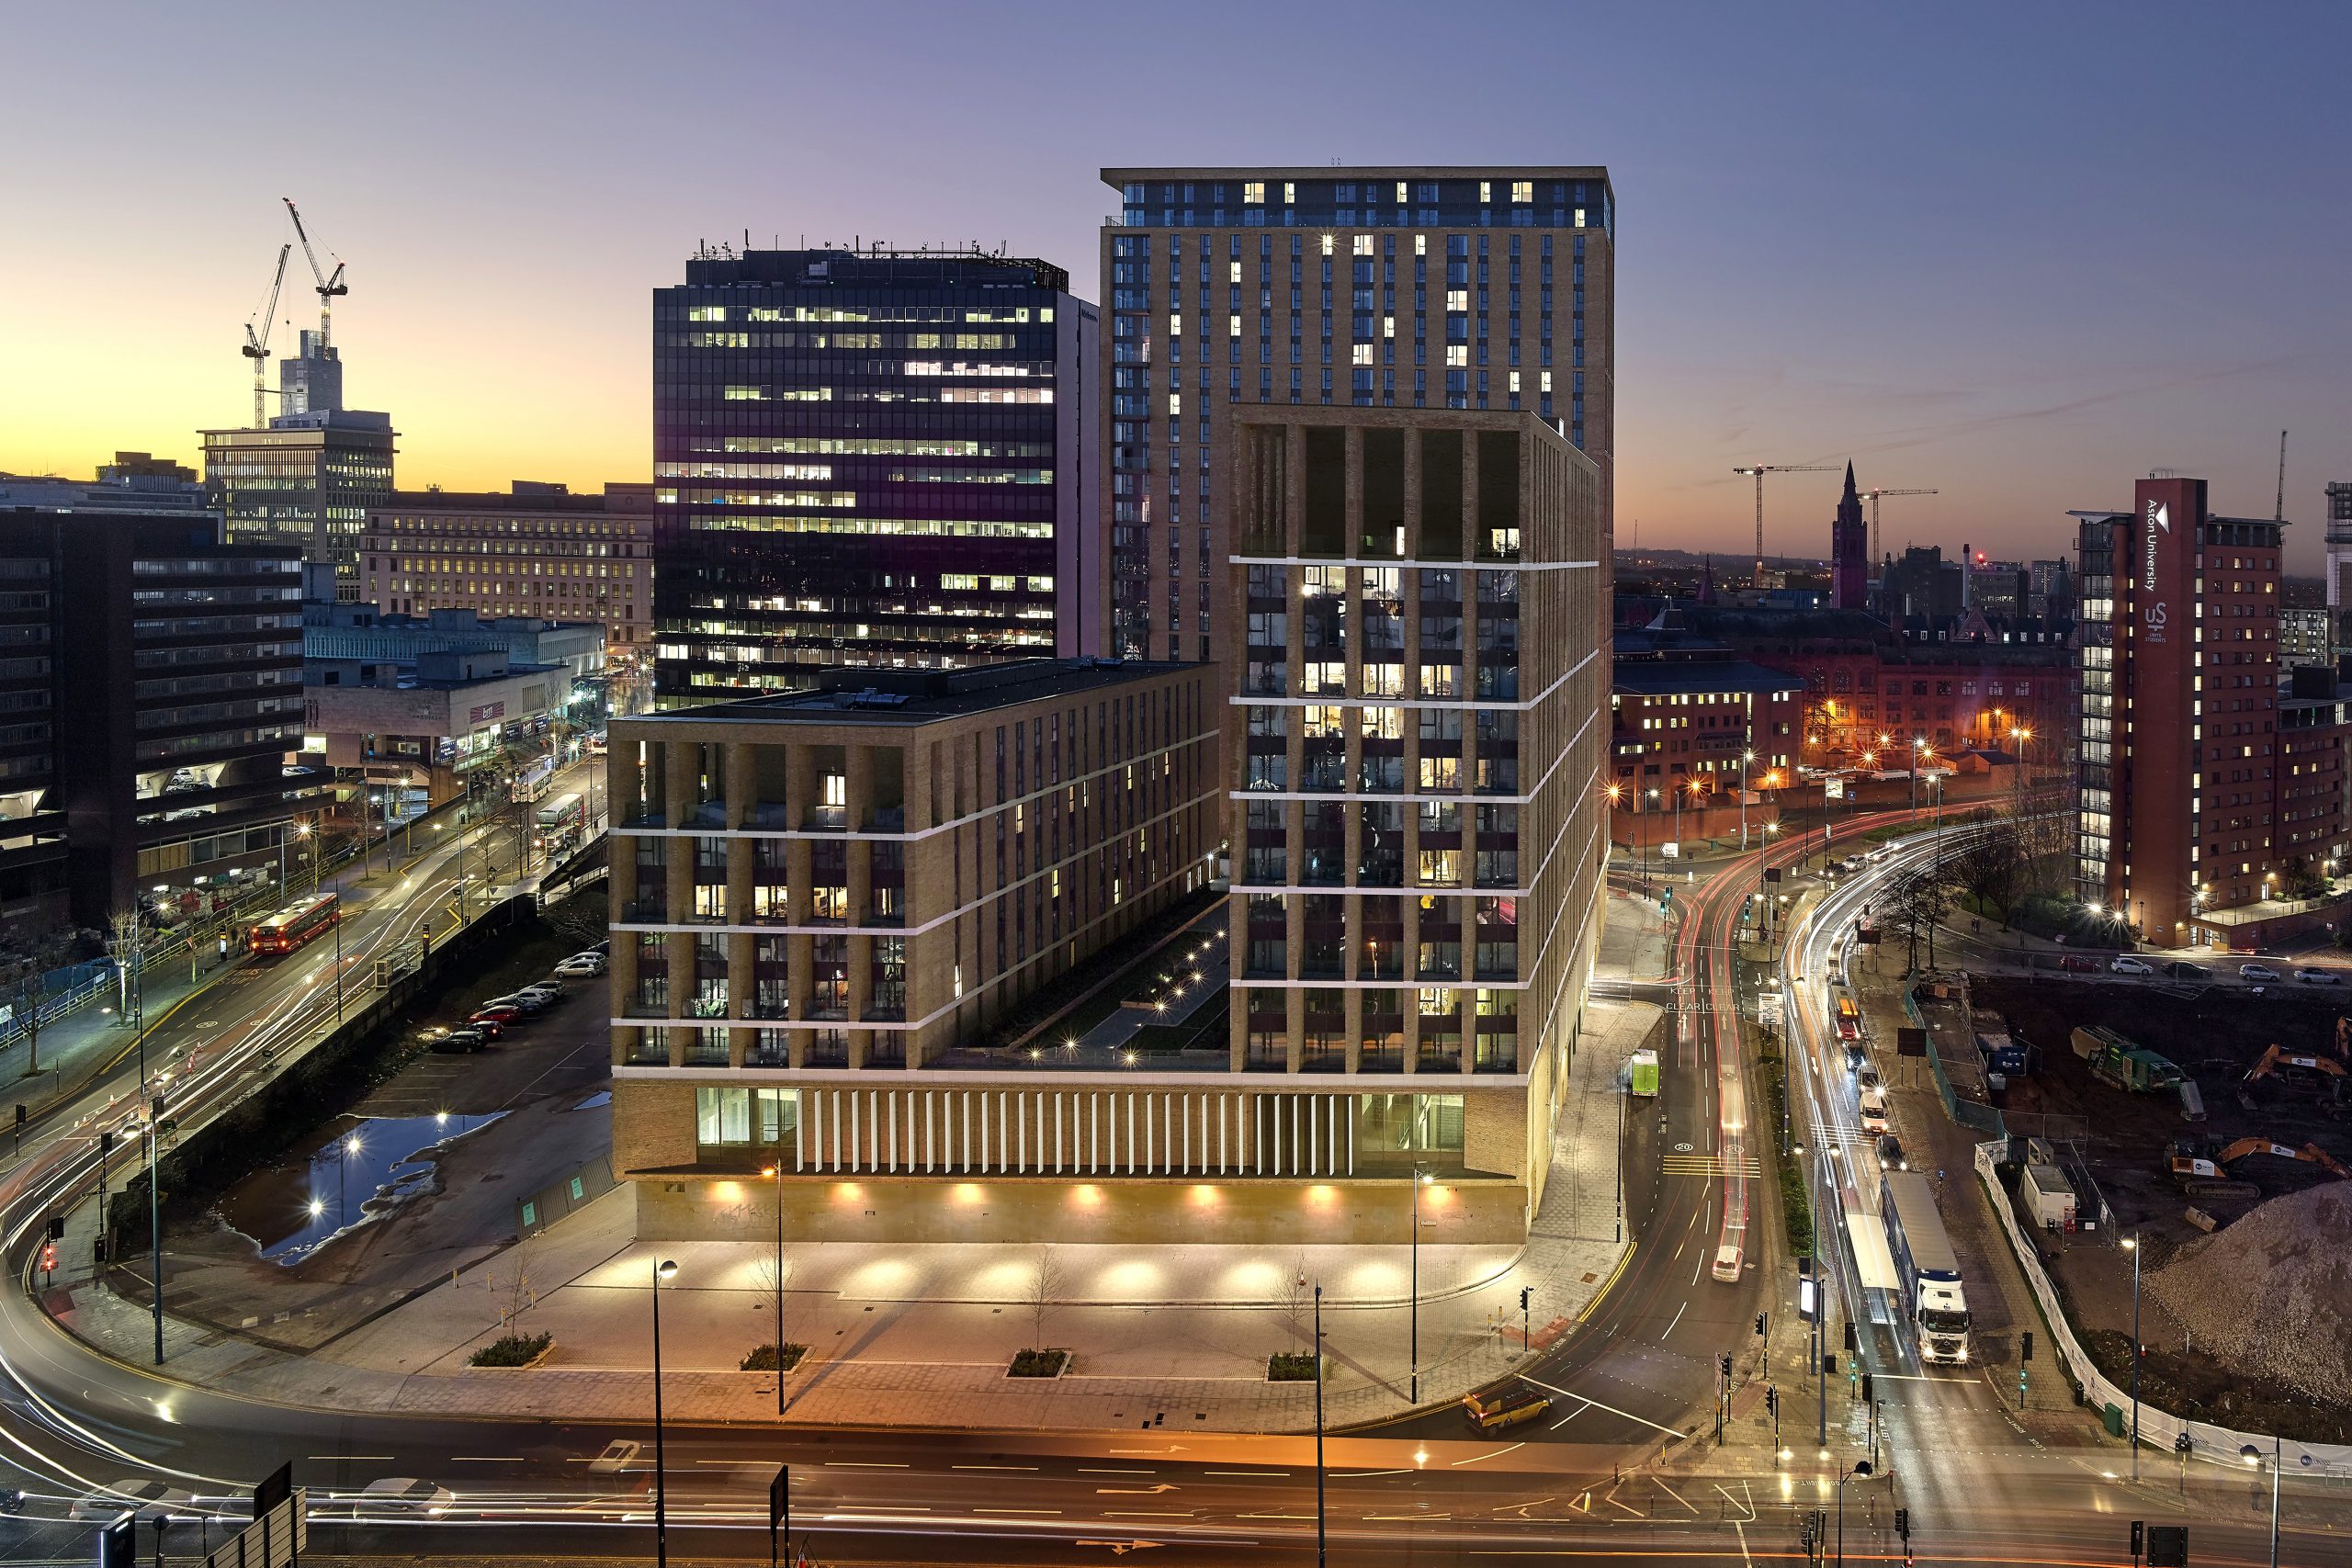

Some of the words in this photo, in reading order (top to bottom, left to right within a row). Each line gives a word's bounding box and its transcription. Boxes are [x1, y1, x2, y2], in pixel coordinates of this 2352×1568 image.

[2148, 499, 2157, 532] Aston
[2145, 536, 2157, 592] University
[1666, 1002, 1701, 1010] CLEAR
[2007, 1420, 2027, 1434] RIGHT
[2029, 1438, 2047, 1451] LOOK
